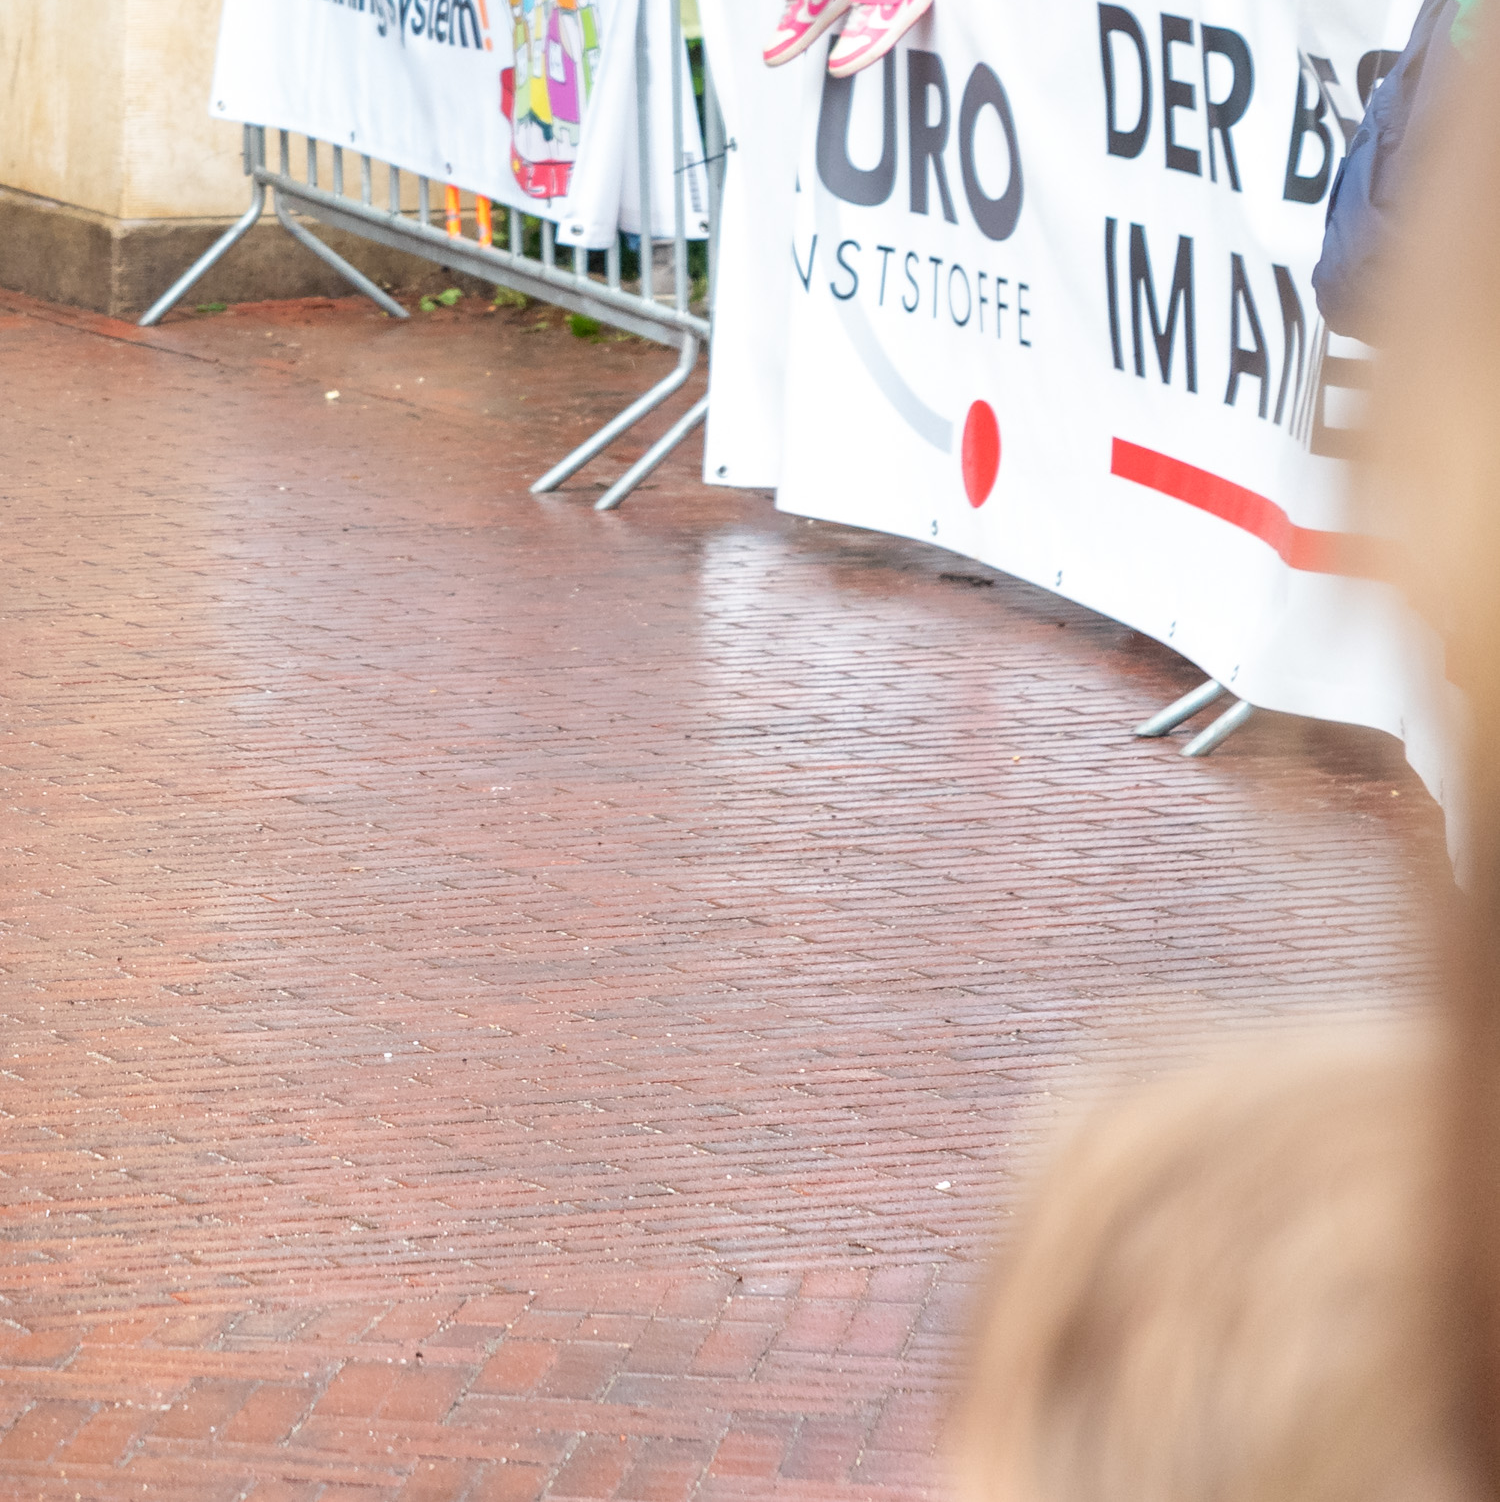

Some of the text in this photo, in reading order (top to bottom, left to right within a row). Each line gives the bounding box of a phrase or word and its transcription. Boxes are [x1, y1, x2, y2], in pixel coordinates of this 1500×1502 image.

[795, 33, 1025, 242] URO
[1097, 1, 1255, 194] DER
[1104, 215, 1199, 395] IM
